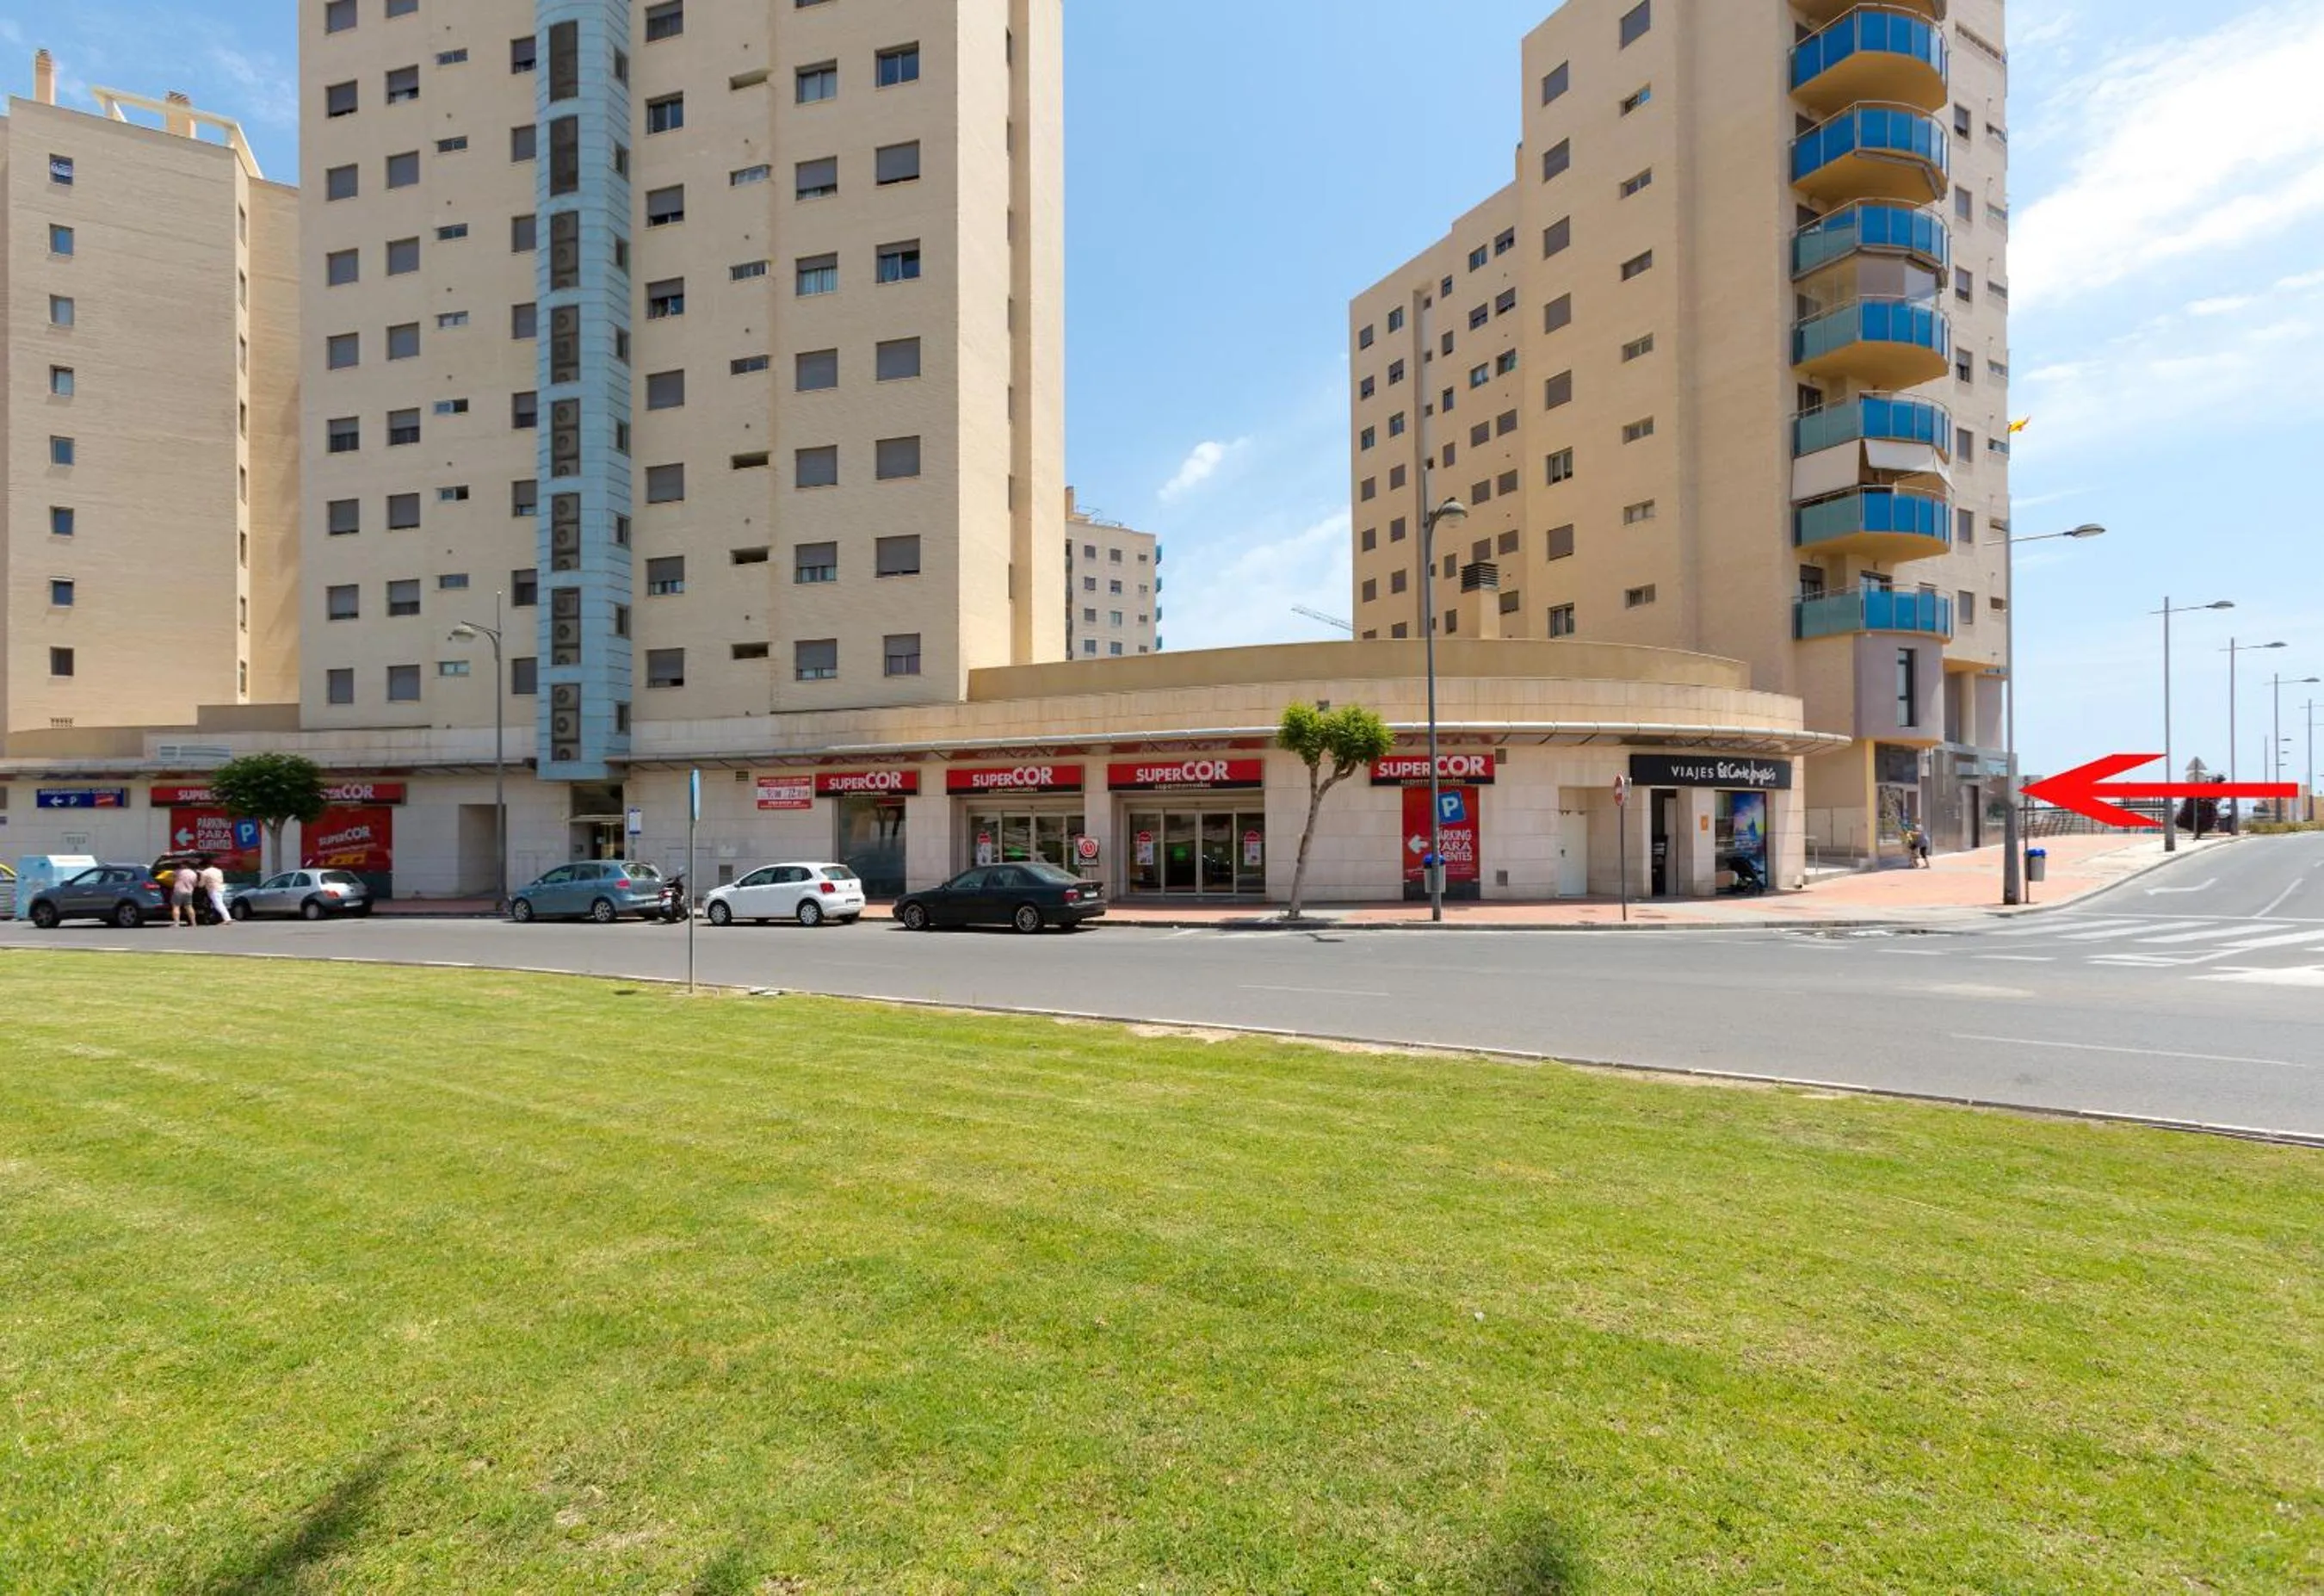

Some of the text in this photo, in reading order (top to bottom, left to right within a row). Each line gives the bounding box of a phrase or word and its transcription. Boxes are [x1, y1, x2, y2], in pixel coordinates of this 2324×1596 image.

[1136, 760, 1230, 783] SUPERCOR
[1378, 756, 1486, 776] SUPERCOR
[1671, 765, 1715, 780] VIAJES
[828, 771, 903, 790] SUPERCOR
[972, 766, 1054, 787] SUPERCOR
[1442, 797, 1459, 817] P
[197, 829, 232, 838] PARA
[241, 823, 255, 843] P
[1439, 829, 1473, 840] ARKING
[1440, 841, 1472, 851] ARA
[1443, 851, 1474, 862] ENTES
